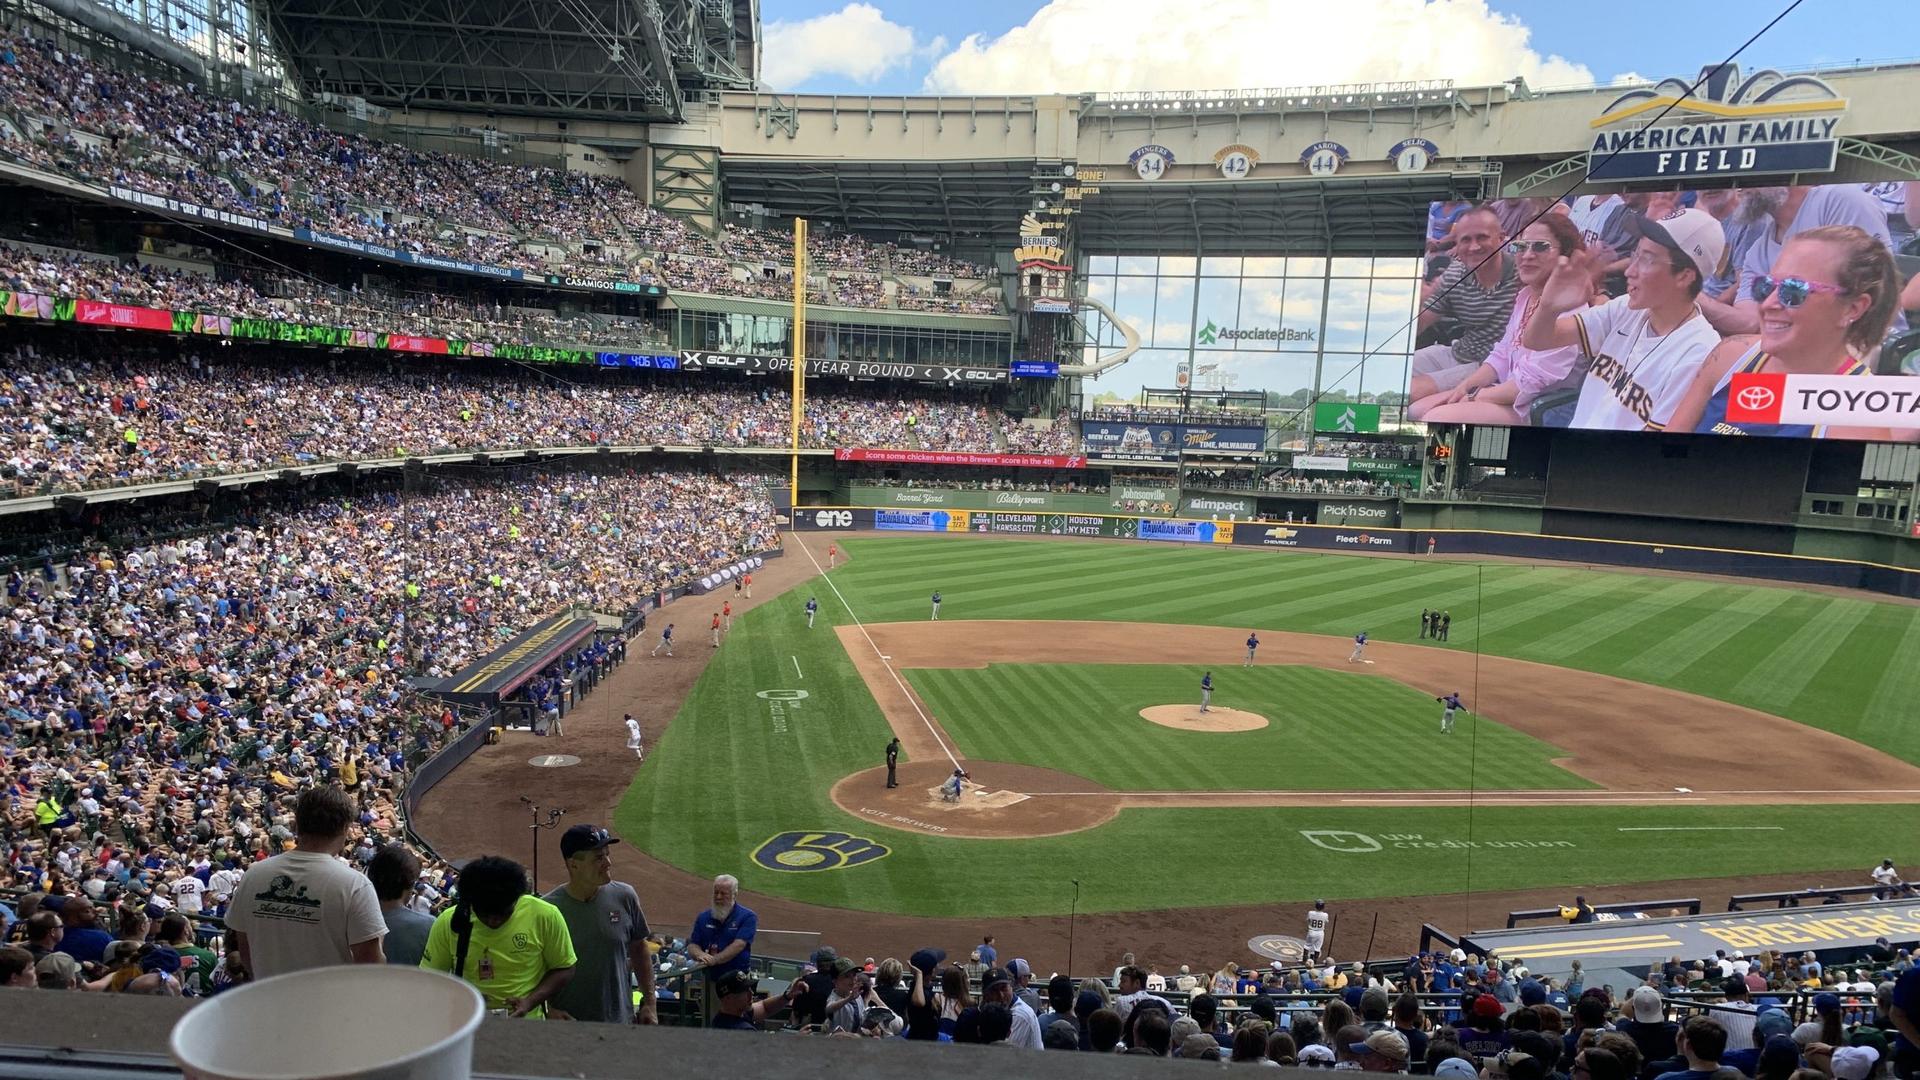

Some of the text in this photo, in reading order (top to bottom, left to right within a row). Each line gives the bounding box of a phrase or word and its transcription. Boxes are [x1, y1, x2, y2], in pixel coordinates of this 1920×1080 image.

[1592, 116, 1841, 152] AMERICAN FAMILY
[1312, 142, 1339, 152] AARON
[1402, 139, 1426, 147] SELIG
[1136, 145, 1168, 156] FINGERS
[1140, 159, 1161, 174] 34
[1225, 158, 1246, 172] 42
[1313, 155, 1334, 171] 44
[1408, 153, 1418, 169] 1
[1657, 148, 1756, 173] FIELD
[1076, 171, 1106, 180] GONE!
[316, 234, 350, 248] Northwestern
[349, 240, 365, 251] Mutual
[367, 245, 385, 256] LEGENDS
[1023, 237, 1057, 246] BERNIE'S
[1014, 246, 1064, 262] CHALET
[419, 255, 511, 277] Northwestern Mutual LEGENDS CLUB
[565, 278, 614, 290] CASAMIGOS
[683, 352, 702, 366] X
[707, 355, 746, 366] GOLF
[813, 361, 850, 374] YEAR
[858, 364, 915, 377] ROUND
[943, 367, 962, 380] X
[966, 371, 1006, 380] GOLF
[1183, 432, 1217, 446] Miller
[1200, 441, 1258, 450] TIME, MILWAUKEE
[865, 451, 885, 460] Score
[907, 453, 935, 461] chicken
[936, 454, 955, 462] when
[956, 454, 968, 462] the
[1001, 457, 1021, 465] score
[1030, 457, 1042, 465] the
[895, 493, 944, 505] Barrel Yard
[996, 492, 1045, 507] Bally SPORTS
[1120, 488, 1166, 500] Johnsonville
[1201, 497, 1245, 511] impact
[815, 510, 853, 527] one
[996, 514, 1037, 523] CLEVELAND
[1358, 507, 1387, 518] Save
[911, 515, 930, 526] SHIRT
[1069, 516, 1104, 525] HOUSTON
[996, 524, 1021, 532] KANSAS
[1022, 525, 1037, 533] CITY
[1068, 526, 1078, 534] NY
[1079, 527, 1100, 535] METS
[1142, 524, 1196, 536] HAWAIIAN SHIRT
[1336, 535, 1392, 545] Fleet Farm
[893, 815, 948, 833] BREWERS
[1393, 840, 1577, 849] credit union
[180, 883, 195, 894] 22
[1311, 920, 1323, 928] 88
[1699, 914, 1920, 948] BREWERS
